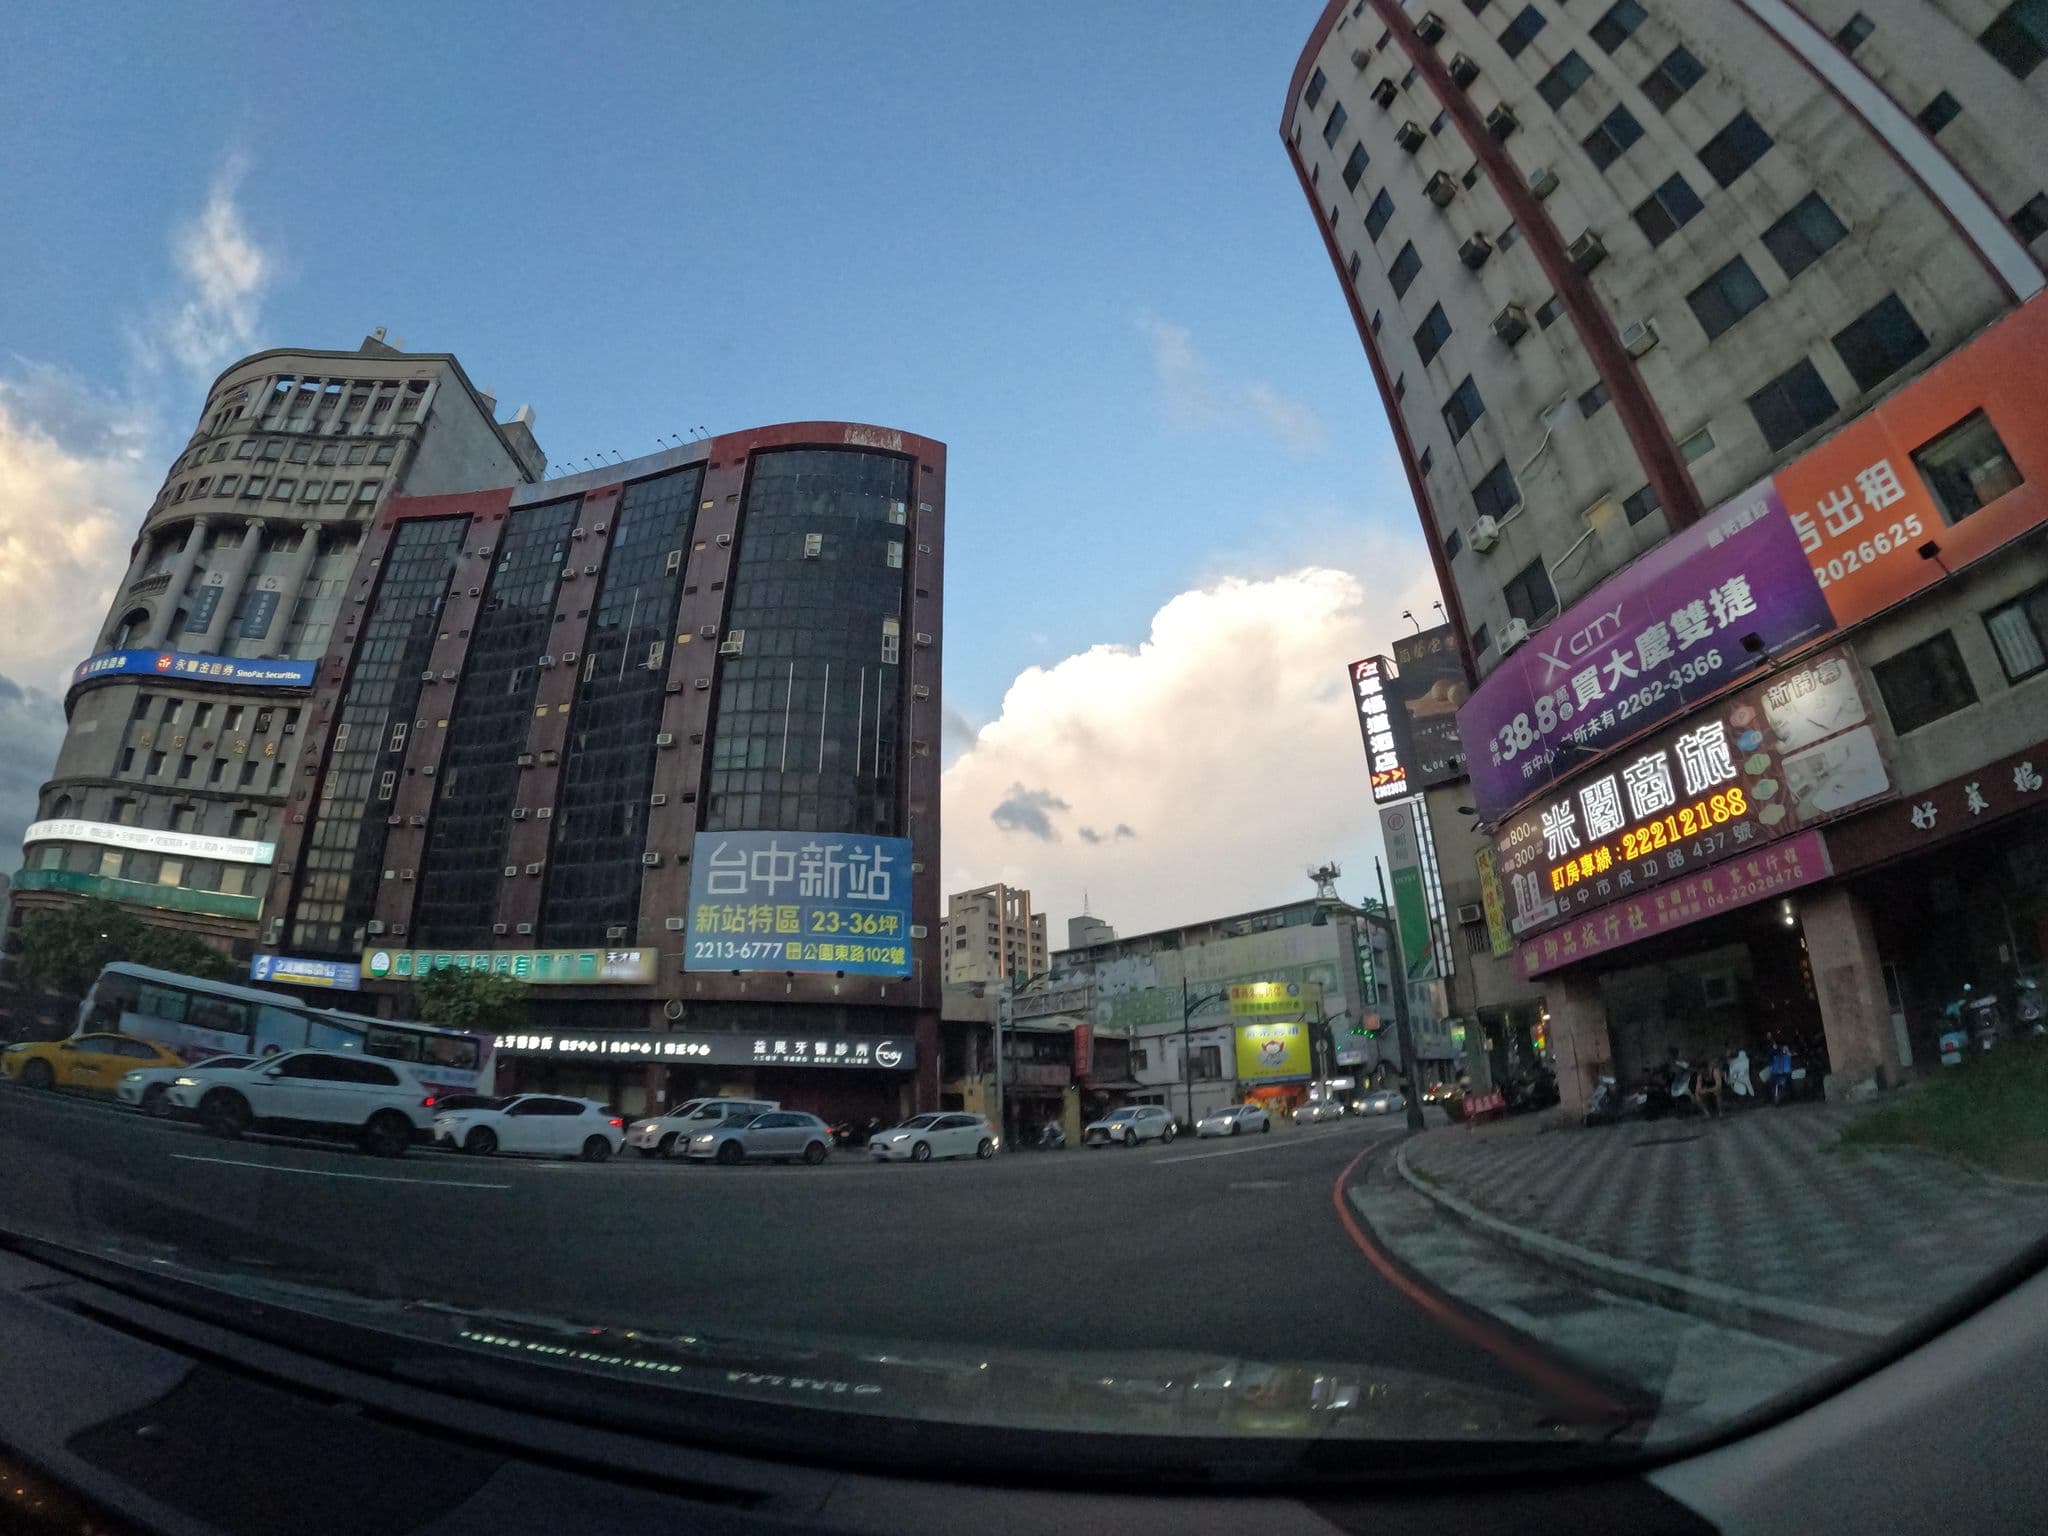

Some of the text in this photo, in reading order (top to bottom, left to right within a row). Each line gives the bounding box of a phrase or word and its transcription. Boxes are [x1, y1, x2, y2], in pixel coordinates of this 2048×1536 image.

[1570, 603, 1623, 656] CITY
[1571, 574, 1757, 712] 買大慶雙捷
[1617, 648, 1724, 721] 2262-3366
[1499, 695, 1558, 761] 38.8
[1541, 720, 1737, 861] 米閣商旅
[708, 840, 894, 901] 台中新站
[695, 904, 899, 936] 新站特區 23-36坪
[695, 941, 784, 960] 2213-6777
